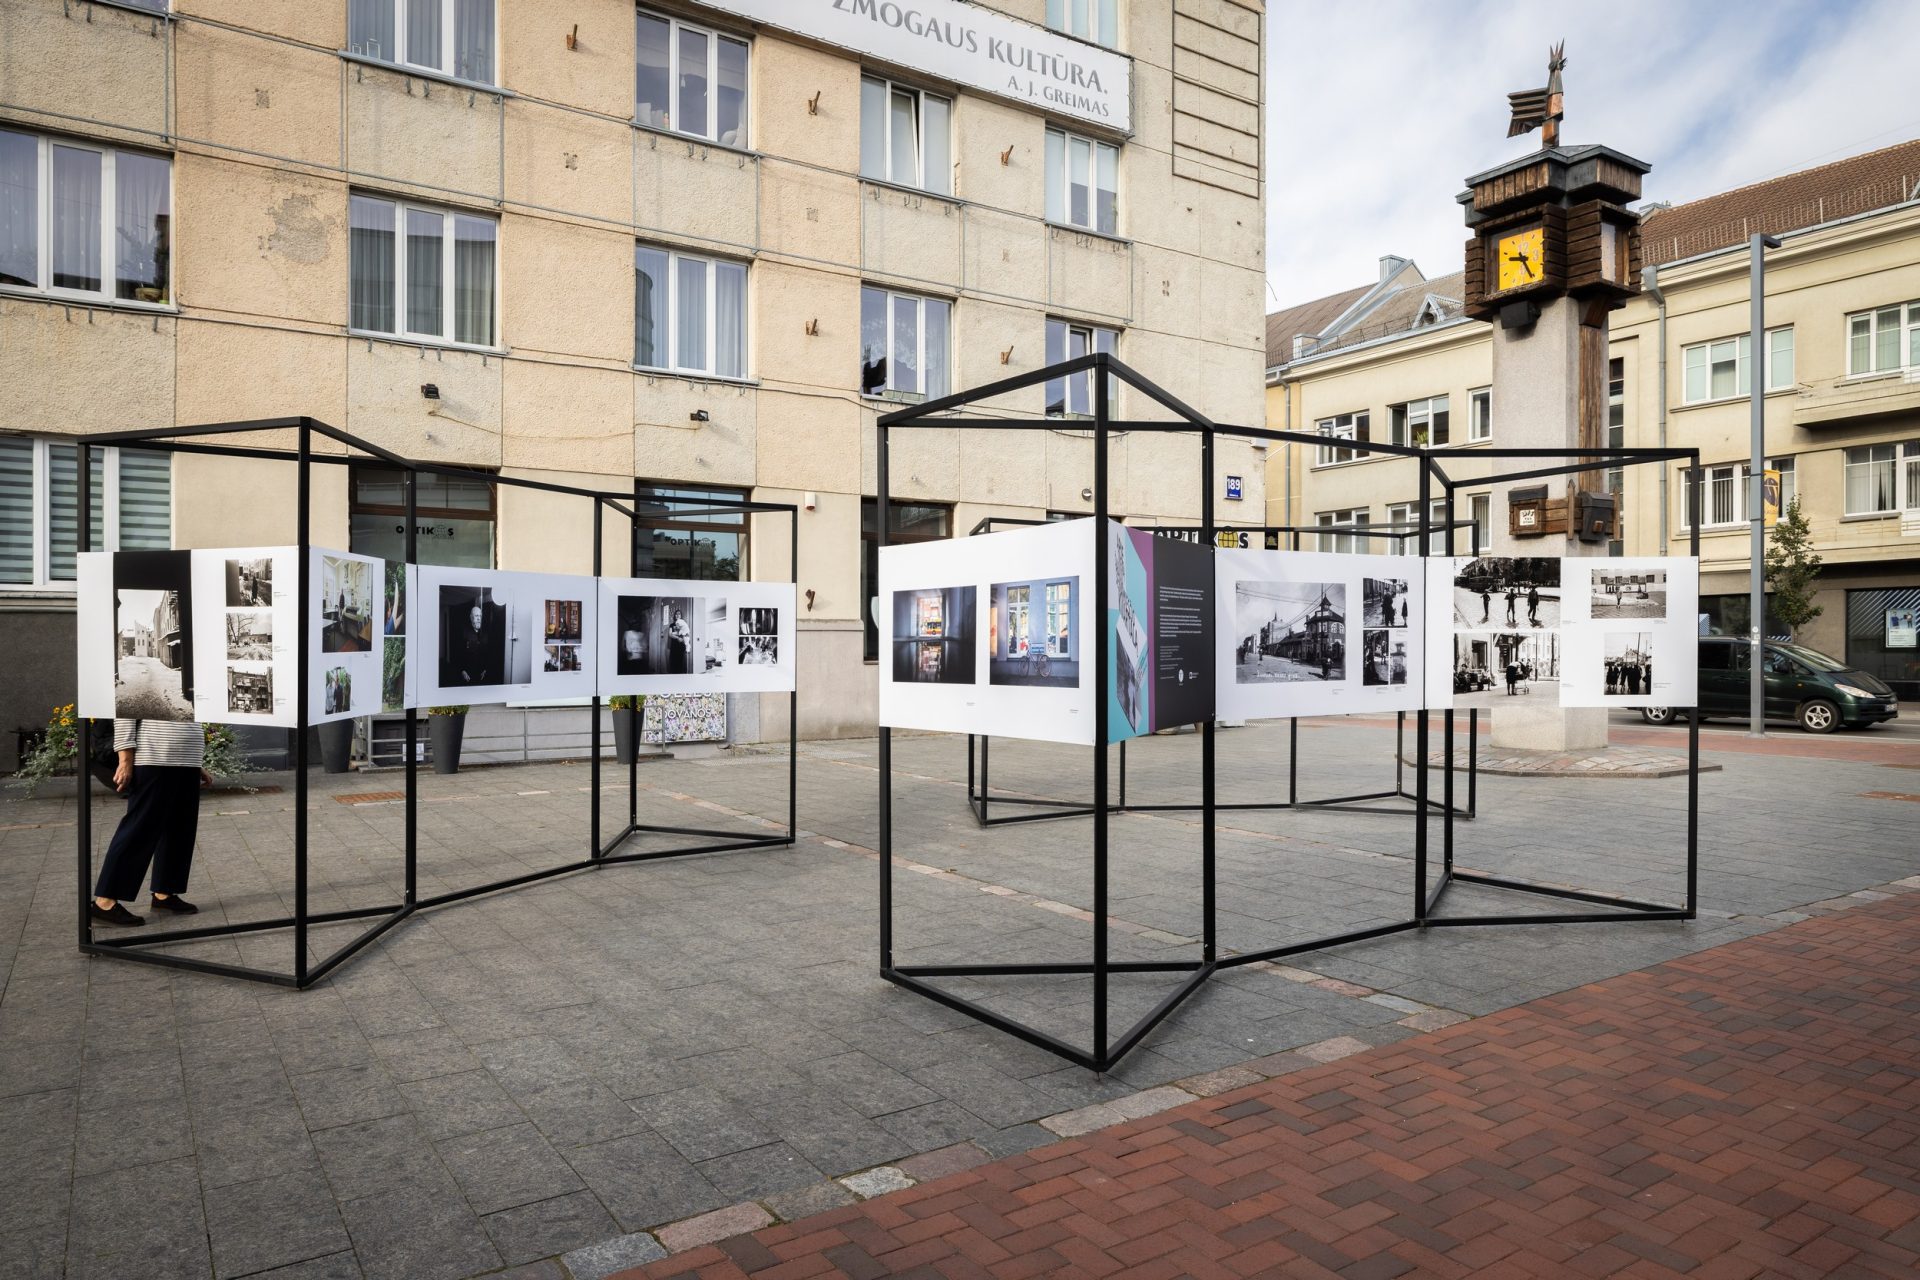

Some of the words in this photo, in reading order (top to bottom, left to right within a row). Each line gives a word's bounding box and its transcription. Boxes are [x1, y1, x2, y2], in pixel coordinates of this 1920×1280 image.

[988, 36, 1109, 95] KULTŪRA.
[1008, 75, 1023, 92] A.
[1029, 83, 1038, 98] J.
[1043, 86, 1109, 117] GREIMAS
[1227, 478, 1241, 490] 189
